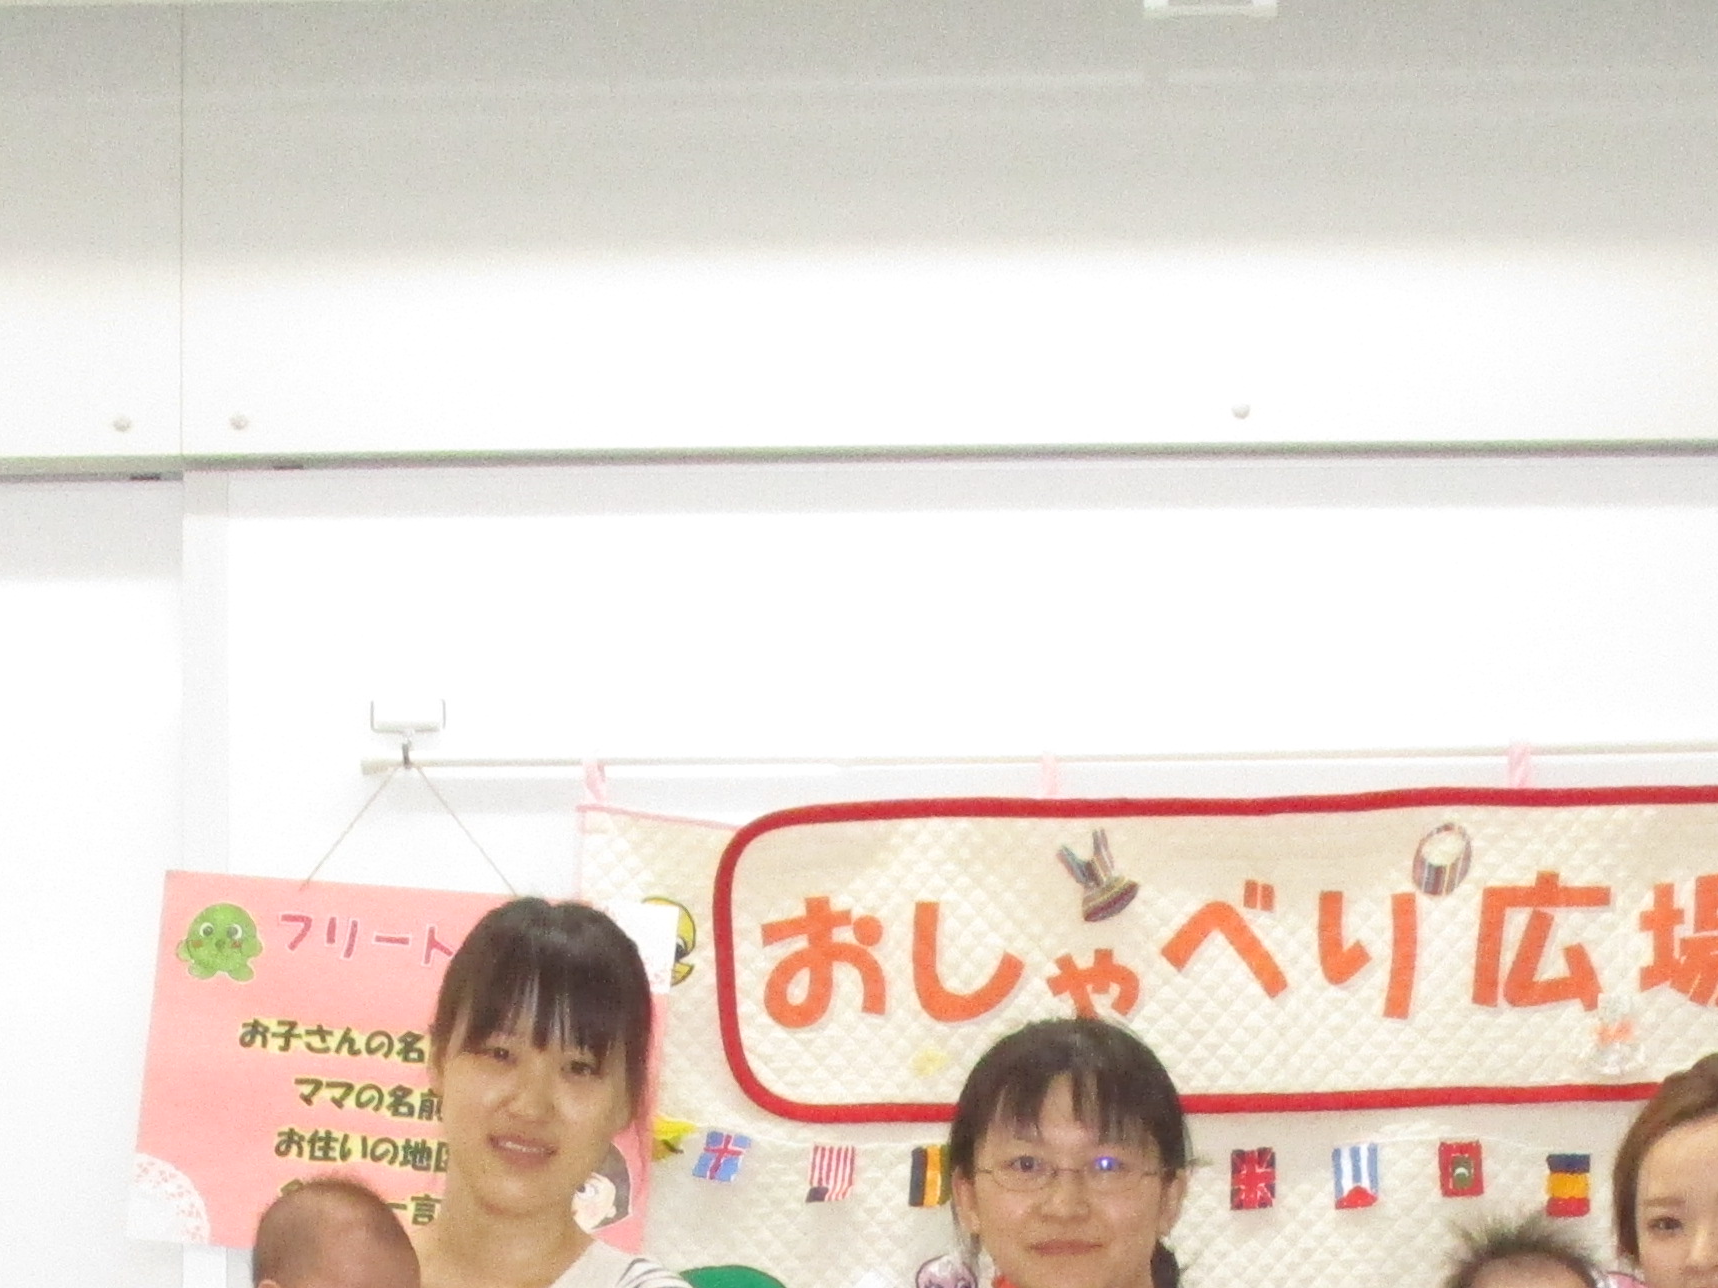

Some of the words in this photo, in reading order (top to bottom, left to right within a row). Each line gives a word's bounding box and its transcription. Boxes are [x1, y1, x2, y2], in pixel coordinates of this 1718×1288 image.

[280, 914, 454, 965] フリート
[238, 1018, 425, 1064] お子さんの名
[294, 1077, 443, 1122] ママの名前
